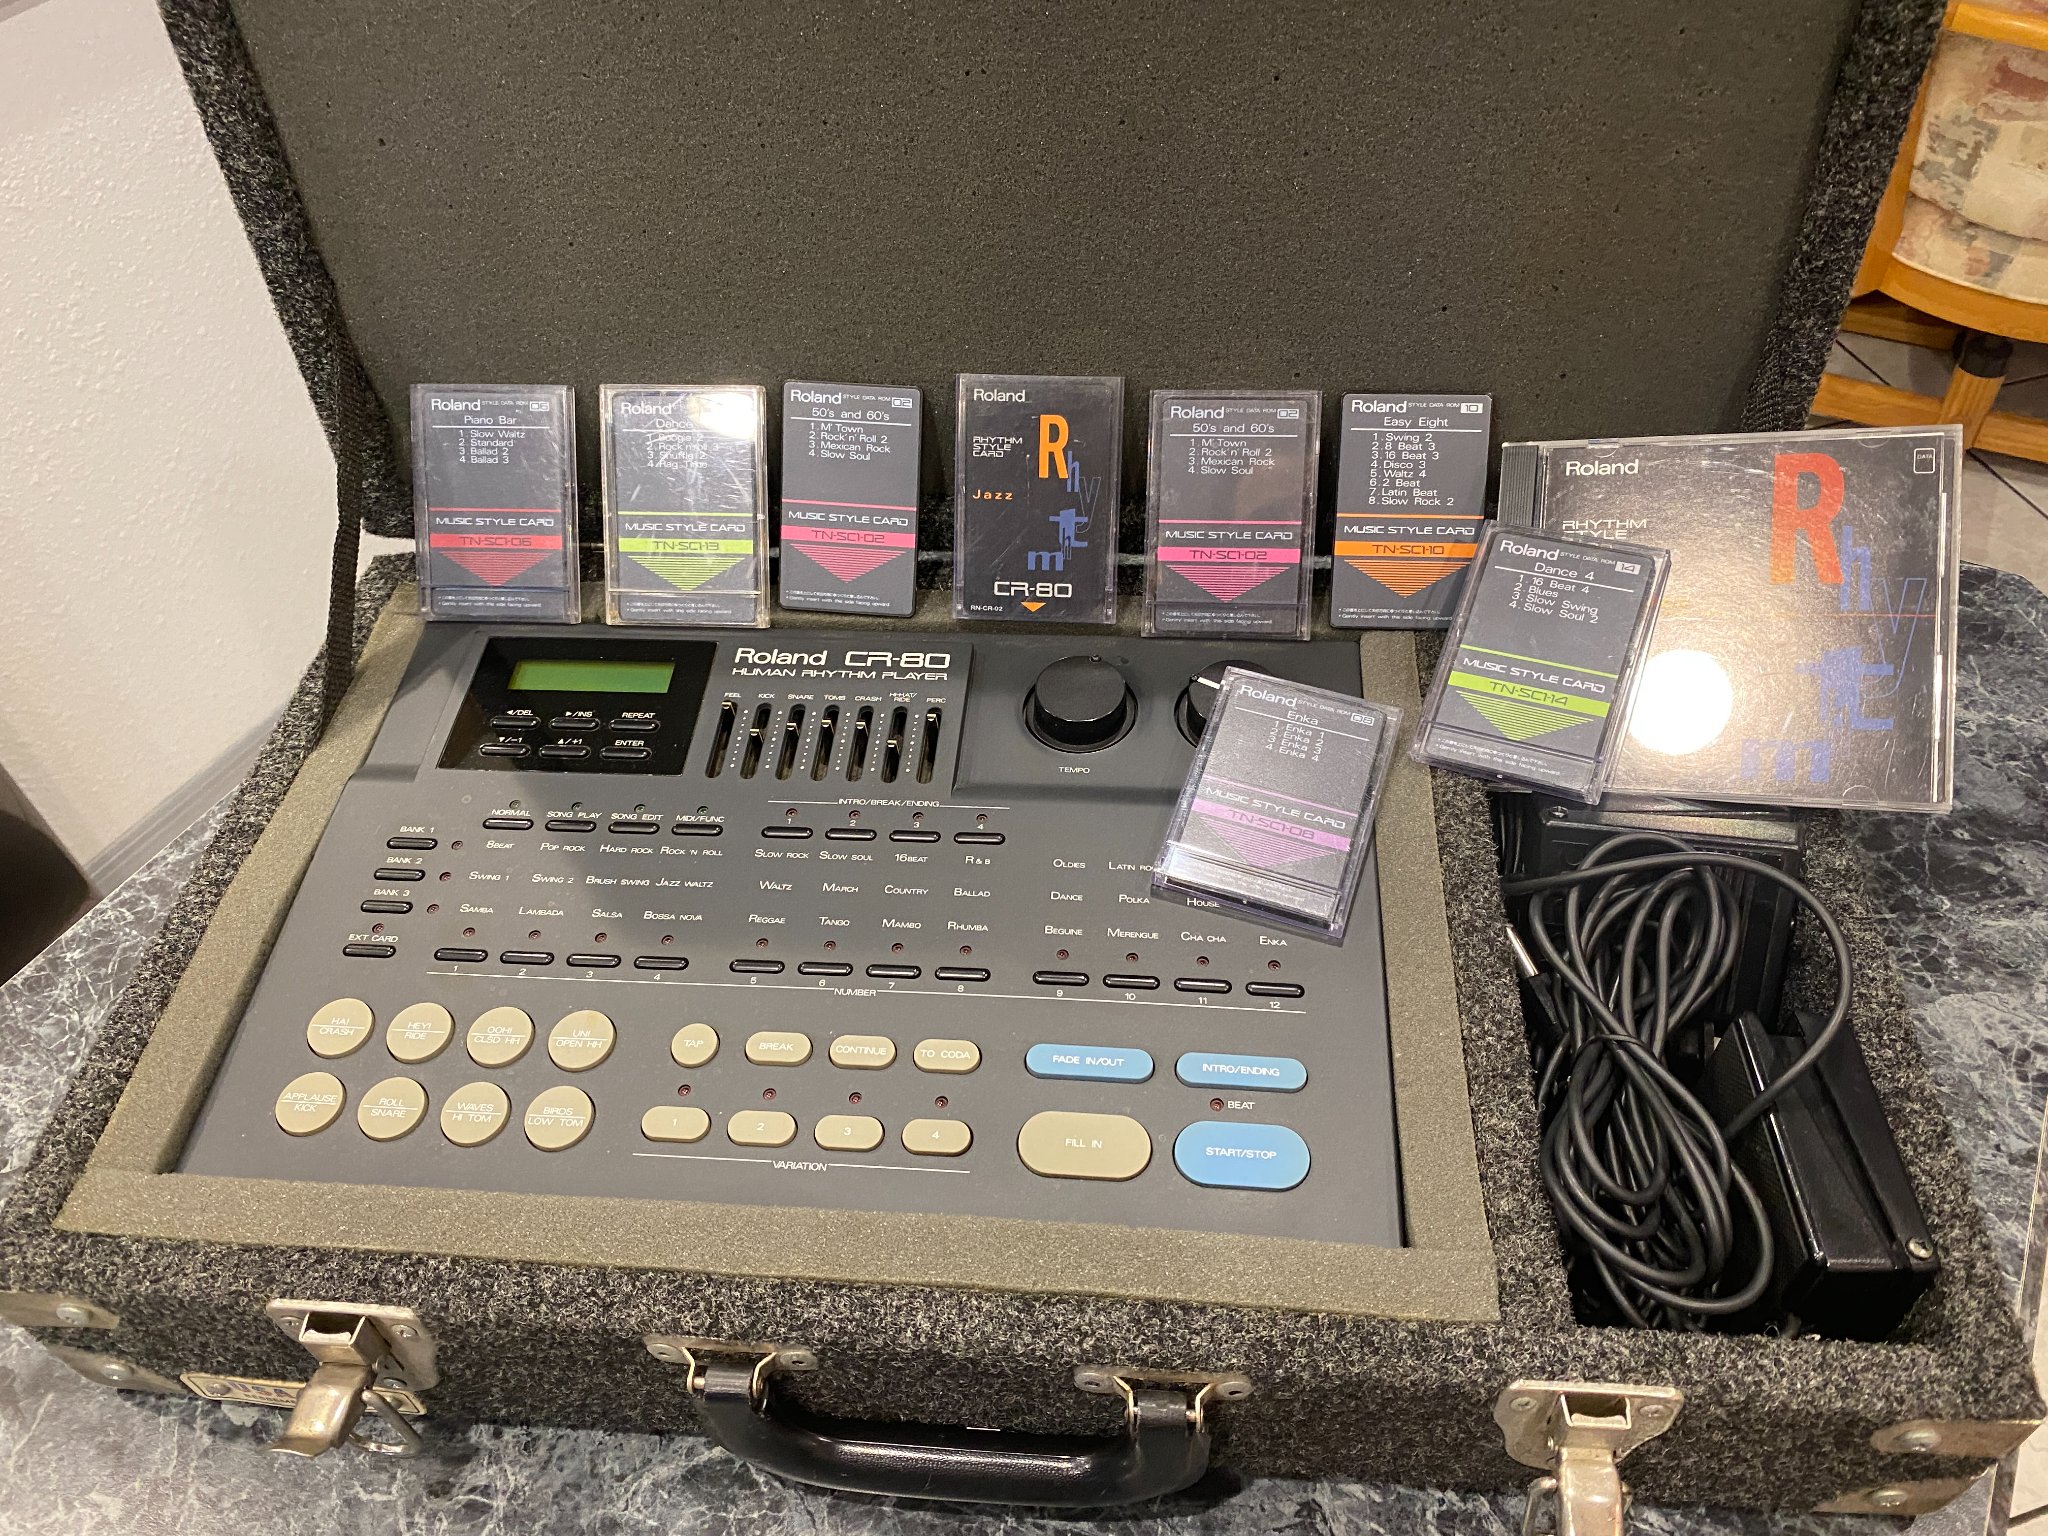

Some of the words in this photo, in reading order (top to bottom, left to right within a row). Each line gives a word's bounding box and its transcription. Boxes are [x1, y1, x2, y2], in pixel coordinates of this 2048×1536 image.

[791, 390, 841, 404] Roland
[973, 389, 1025, 402] Roland
[431, 398, 481, 411] Roland
[621, 402, 672, 415] Roland
[1351, 400, 1407, 413] Roland
[812, 408, 835, 418] 50's
[841, 410, 862, 419] and
[867, 410, 890, 421] 60's
[1170, 406, 1224, 419] Roland
[464, 416, 494, 425] Piano
[499, 416, 517, 425] Bar
[656, 419, 693, 428] Dance
[1384, 418, 1412, 427] Easy
[1418, 418, 1449, 428] Eight
[1192, 423, 1216, 433] 50's
[1223, 424, 1245, 433] and
[1250, 424, 1274, 433] 60's
[470, 430, 494, 438] Slow
[498, 430, 525, 439] Waltz
[973, 436, 1022, 444] RHYTHM
[821, 442, 861, 452] Mexican
[866, 443, 891, 453] Rock
[973, 450, 1004, 458] CARD
[1384, 461, 1413, 469] Disco
[1419, 461, 1426, 469] 3
[1565, 459, 1639, 476] Roland
[972, 489, 1013, 500] Jazz
[1382, 488, 1407, 497] Latin
[1413, 488, 1438, 497] Beat
[435, 517, 473, 526] MUSIC
[475, 517, 516, 527] STYLE
[519, 518, 554, 527] CARD
[788, 511, 825, 520] MUSIC
[829, 513, 870, 523] STYLE
[873, 516, 909, 526] CARD
[625, 523, 662, 531] MUSIC
[666, 523, 707, 532] STYLE
[711, 524, 745, 532] CARD
[1562, 519, 1647, 530] RHYTHM
[1166, 531, 1204, 539] MUSIC
[1208, 532, 1251, 540] STYLE
[1256, 532, 1293, 540] CARD
[1344, 526, 1384, 534] MUSIC
[1388, 526, 1433, 535] STYLE
[1436, 527, 1475, 536] CARD
[1500, 540, 1560, 561] Roland
[1534, 562, 1578, 578] Dance
[1584, 571, 1594, 581] 4
[994, 582, 1072, 598] CR-80
[1526, 594, 1556, 606] Slow
[1562, 600, 1599, 615] Swing
[734, 648, 828, 666] Roland
[845, 651, 951, 669] CR-80
[732, 668, 796, 678] HUMAN
[802, 669, 876, 679] RHYTHM
[881, 671, 948, 681] PLAYER
[1463, 657, 1507, 674] MUSIC
[1509, 668, 1558, 684] STYLE
[1562, 678, 1605, 694] CARD
[1239, 685, 1297, 707] Roland
[1287, 710, 1318, 726] Enka
[1058, 766, 1090, 774] TEMPO
[838, 798, 940, 808] INTRO/BREAK/ENDING
[1206, 786, 1249, 804] MUSIC
[1252, 799, 1301, 818] STYLE
[1304, 812, 1346, 830] CARD
[491, 809, 530, 817] NORMAL
[547, 811, 574, 819] SONG
[576, 812, 602, 820] PLAY
[611, 813, 639, 821] SONG
[641, 814, 664, 822] EDIT
[676, 815, 725, 823] MIDI/FUNC
[400, 826, 426, 834] BANK
[386, 856, 412, 864] BANK
[348, 934, 369, 942] EXT
[371, 934, 398, 943] CARD
[834, 988, 876, 997] NUMBER
[1124, 992, 1136, 1000] 10
[1269, 1001, 1281, 1009] 12
[318, 1027, 355, 1036] CRASH
[404, 1032, 427, 1040] RIDE
[556, 1039, 583, 1048] OPEN
[586, 1040, 604, 1049] HH
[684, 1039, 704, 1048] TAP
[758, 1042, 794, 1051] BREAK
[835, 1045, 888, 1056] CONTINUE
[920, 1050, 936, 1058] TO
[940, 1050, 971, 1060] CODA
[1052, 1055, 1080, 1065] FADE
[1085, 1056, 1125, 1067] IN/OUT
[1202, 1064, 1280, 1077] INTRO/ENDING
[282, 1092, 338, 1103] APPLAUSE
[294, 1104, 317, 1112] KICK
[456, 1102, 494, 1112] WAVES
[1227, 1100, 1256, 1110] BEAT
[370, 1108, 408, 1118] SNARE
[452, 1113, 466, 1122] HI
[468, 1114, 492, 1124] TOM
[756, 1122, 765, 1132] 2
[843, 1127, 852, 1136] 3
[1065, 1138, 1086, 1148] FILL
[1091, 1140, 1103, 1148] IN
[1205, 1146, 1277, 1159] START/STOP
[772, 1160, 828, 1172] VARIATION
